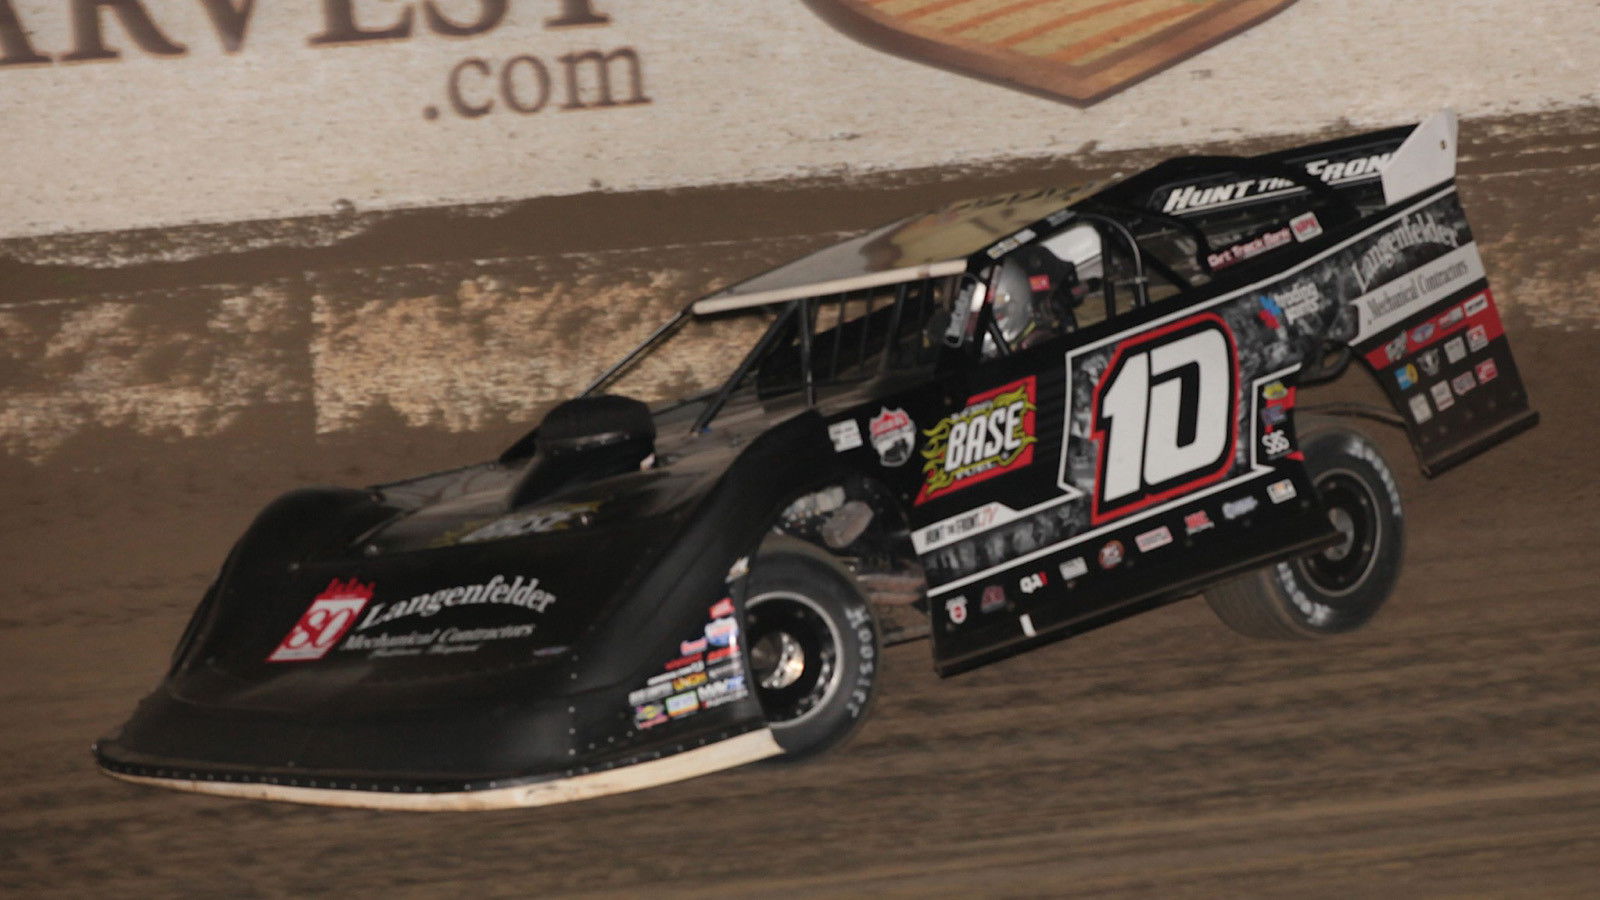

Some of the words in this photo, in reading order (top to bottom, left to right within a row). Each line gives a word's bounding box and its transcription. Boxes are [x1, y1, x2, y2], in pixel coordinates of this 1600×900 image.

[422, 46, 652, 120] .com
[1163, 179, 1255, 213] HUNT
[1305, 152, 1397, 183] FRON
[944, 400, 1025, 473] BASE
[1102, 328, 1231, 503] 10
[338, 628, 440, 650] Mechanical
[437, 622, 536, 644] Contractors
[356, 574, 556, 631] Langenfelder
